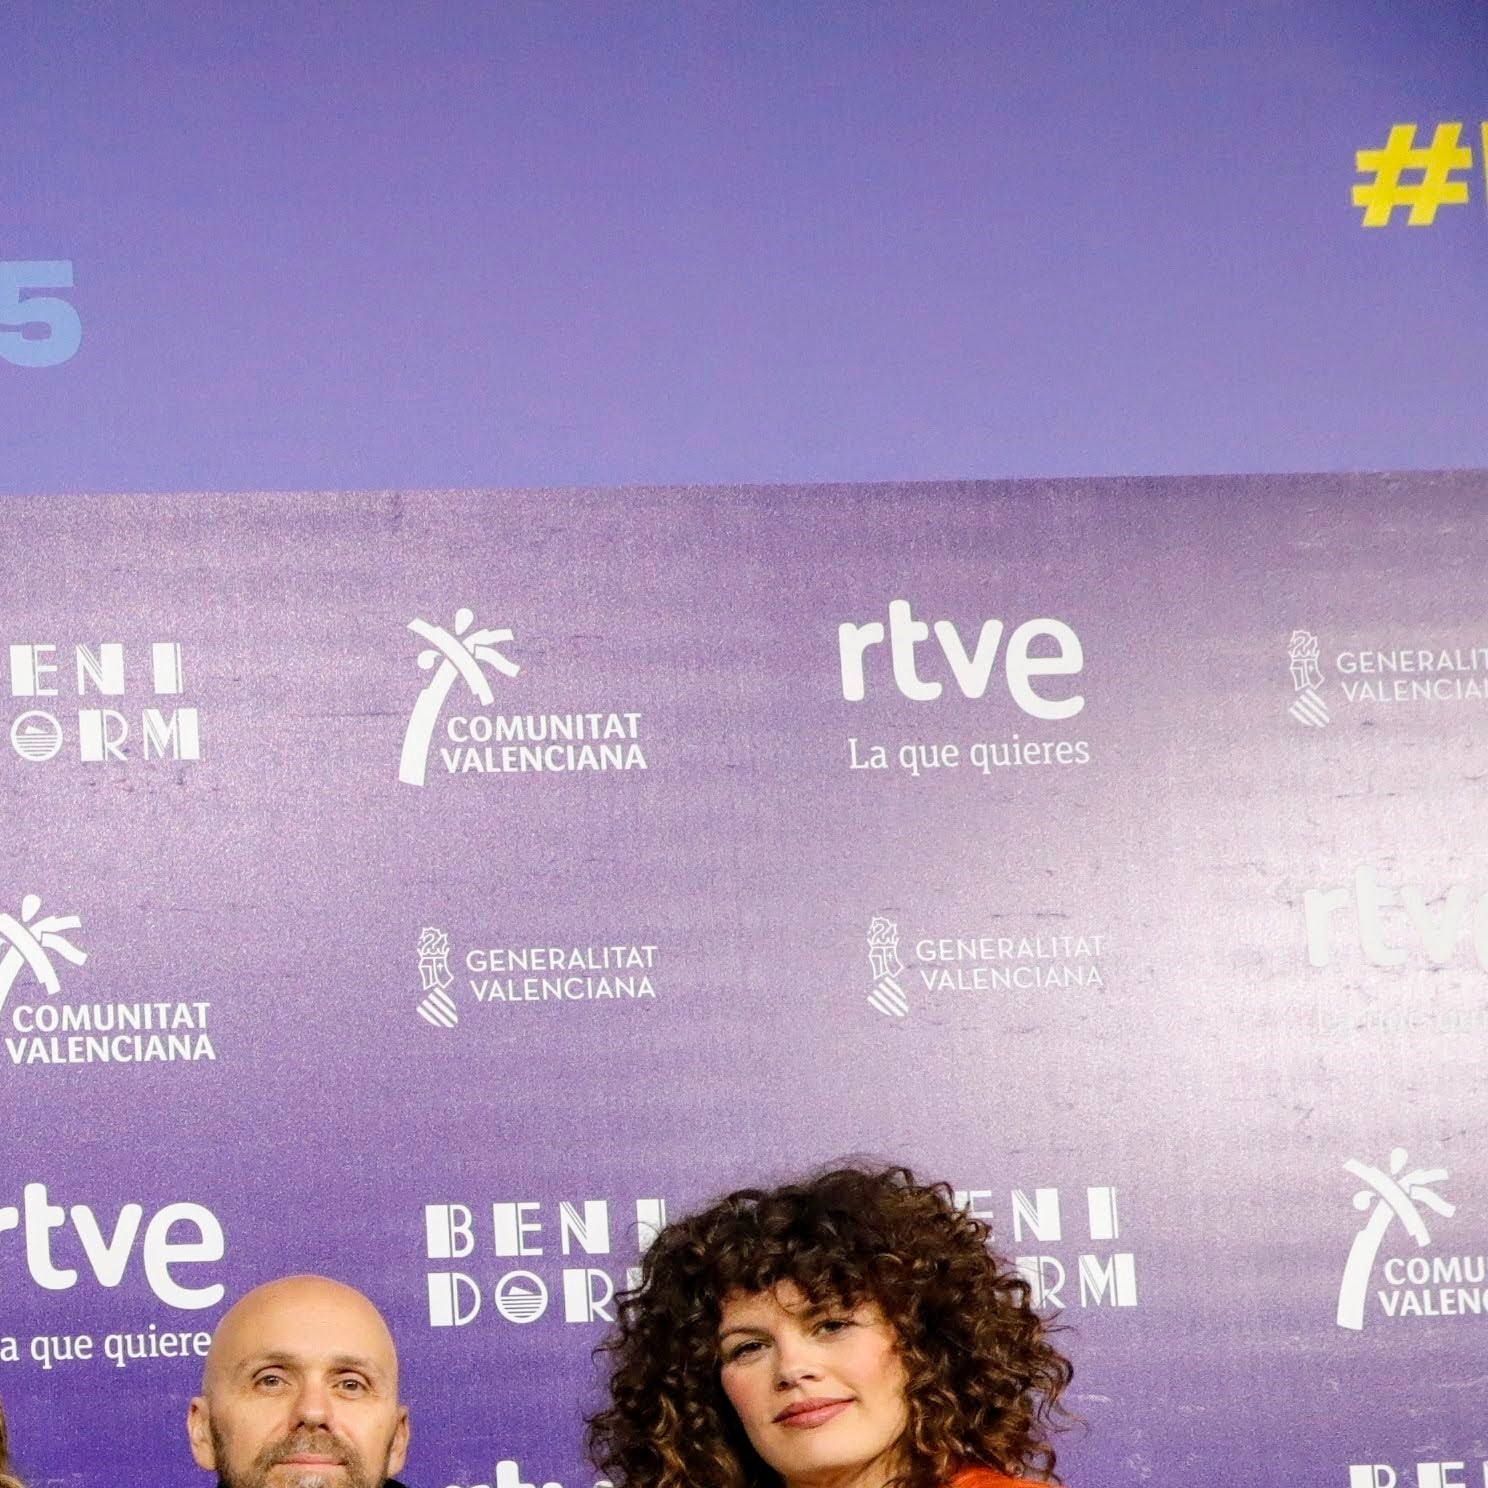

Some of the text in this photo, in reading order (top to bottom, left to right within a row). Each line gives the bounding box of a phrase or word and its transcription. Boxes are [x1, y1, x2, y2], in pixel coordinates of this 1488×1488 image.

[839, 600, 1085, 720] rtve
[1341, 678, 1488, 702] VALENCIA
[447, 712, 641, 741] COMUNITAT
[441, 744, 648, 773] VALENCIANA
[848, 734, 1090, 776] La que quieres
[1303, 865, 1488, 967] rtv
[466, 945, 658, 972] GENERALITAT
[915, 936, 1105, 962] GENERALITAT
[470, 974, 656, 1001] VALENCIANA
[920, 965, 1103, 990] VALENCIANA
[13, 1002, 210, 1032] COMUNITAT
[6, 1035, 216, 1064] VALENCIANA
[1384, 1256, 1488, 1285] COMU
[30, 1335, 93, 1369] que
[104, 1324, 212, 1367] quiere
